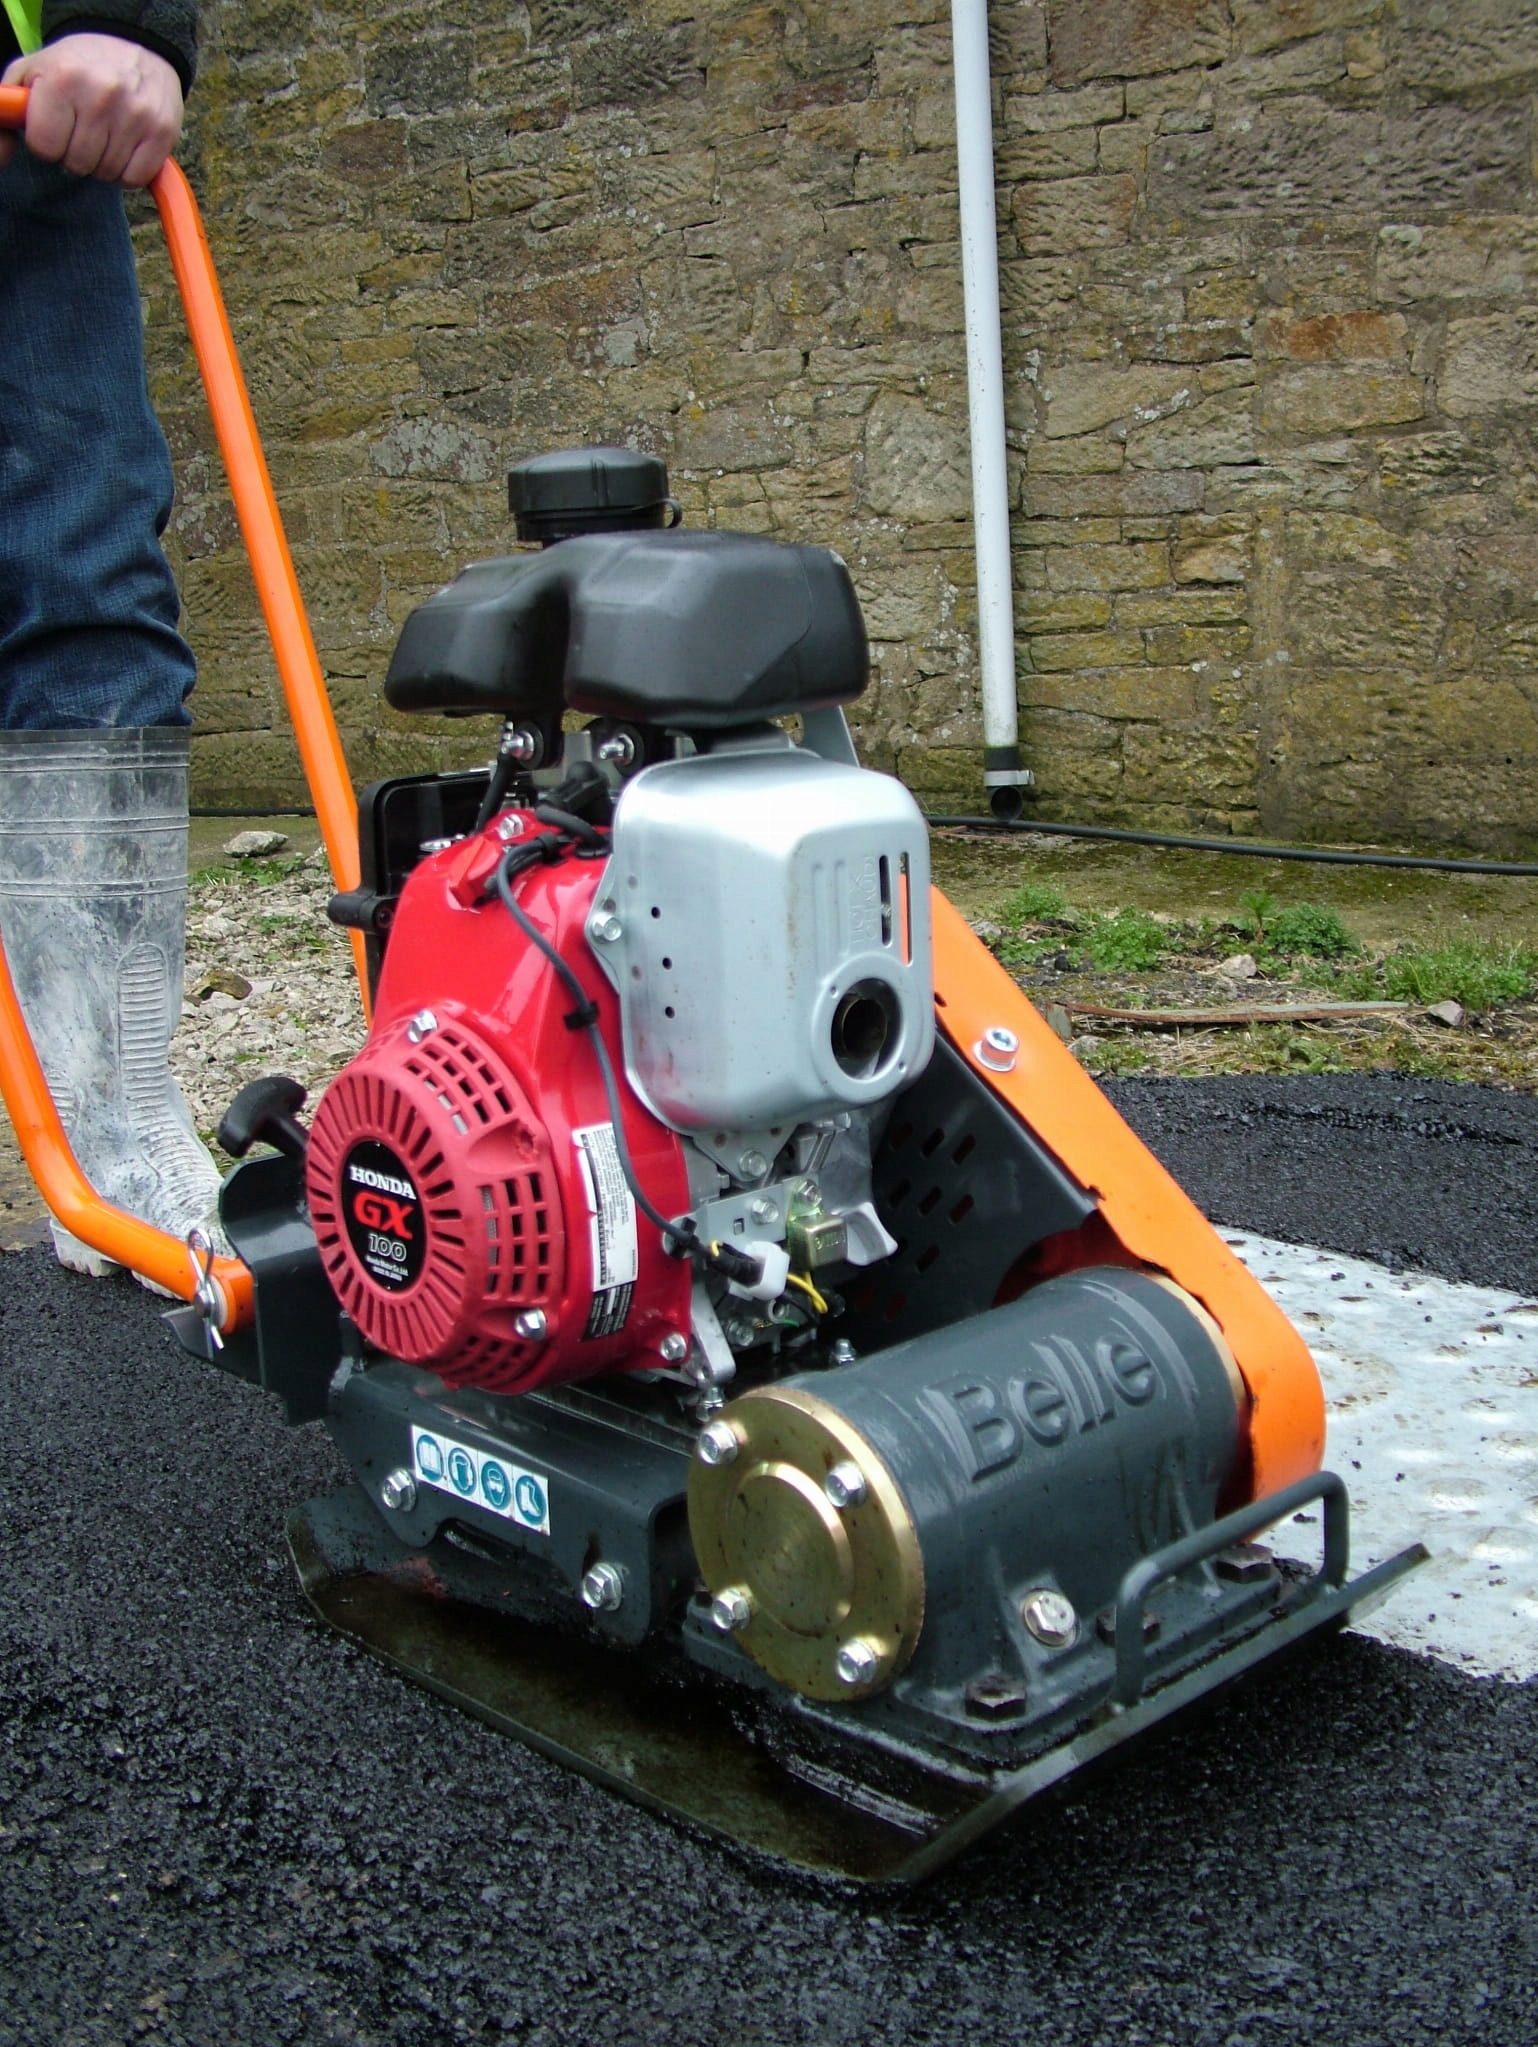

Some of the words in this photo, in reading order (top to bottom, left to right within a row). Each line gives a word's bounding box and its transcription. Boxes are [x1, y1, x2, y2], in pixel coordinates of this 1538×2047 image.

[350, 1165, 417, 1201] HONDA
[353, 1190, 414, 1240] GX
[368, 1232, 407, 1262] 100
[920, 1335, 1160, 1484] Belle
